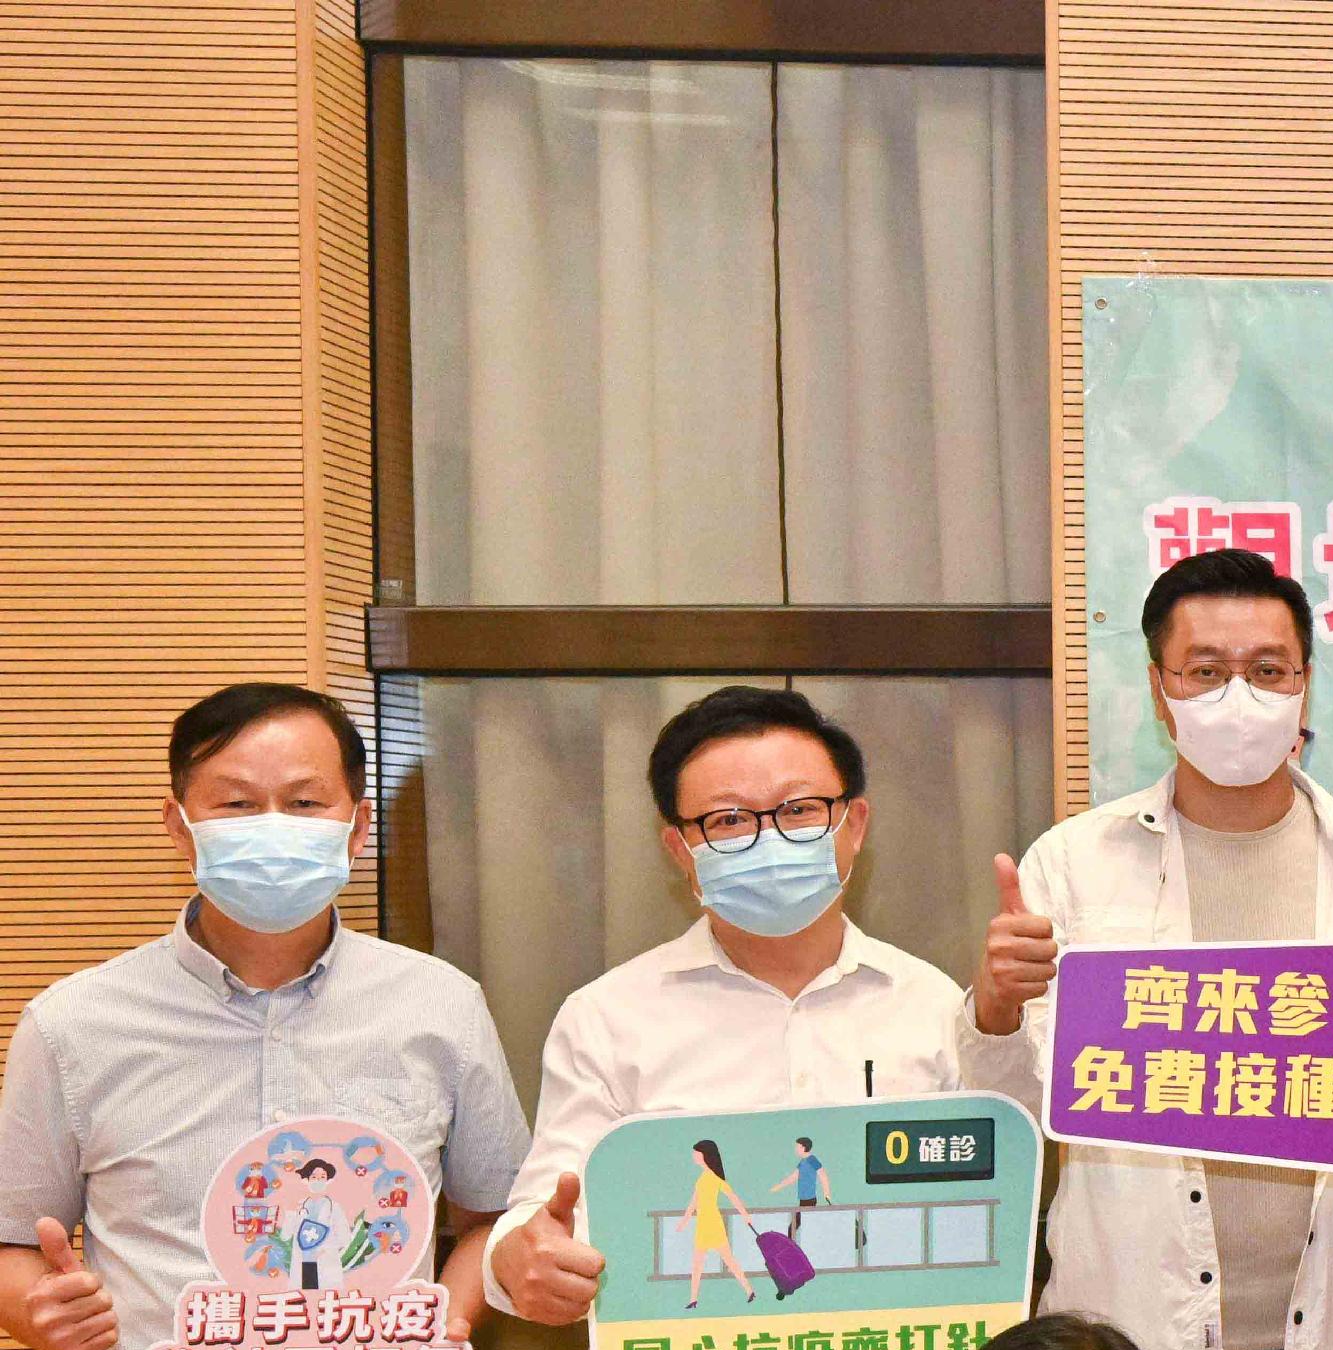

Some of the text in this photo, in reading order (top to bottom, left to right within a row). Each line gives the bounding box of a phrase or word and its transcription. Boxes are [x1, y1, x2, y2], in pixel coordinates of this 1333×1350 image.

[885, 1130, 976, 1164] 0 確診
[185, 1289, 439, 1345] 攜手抗疫
